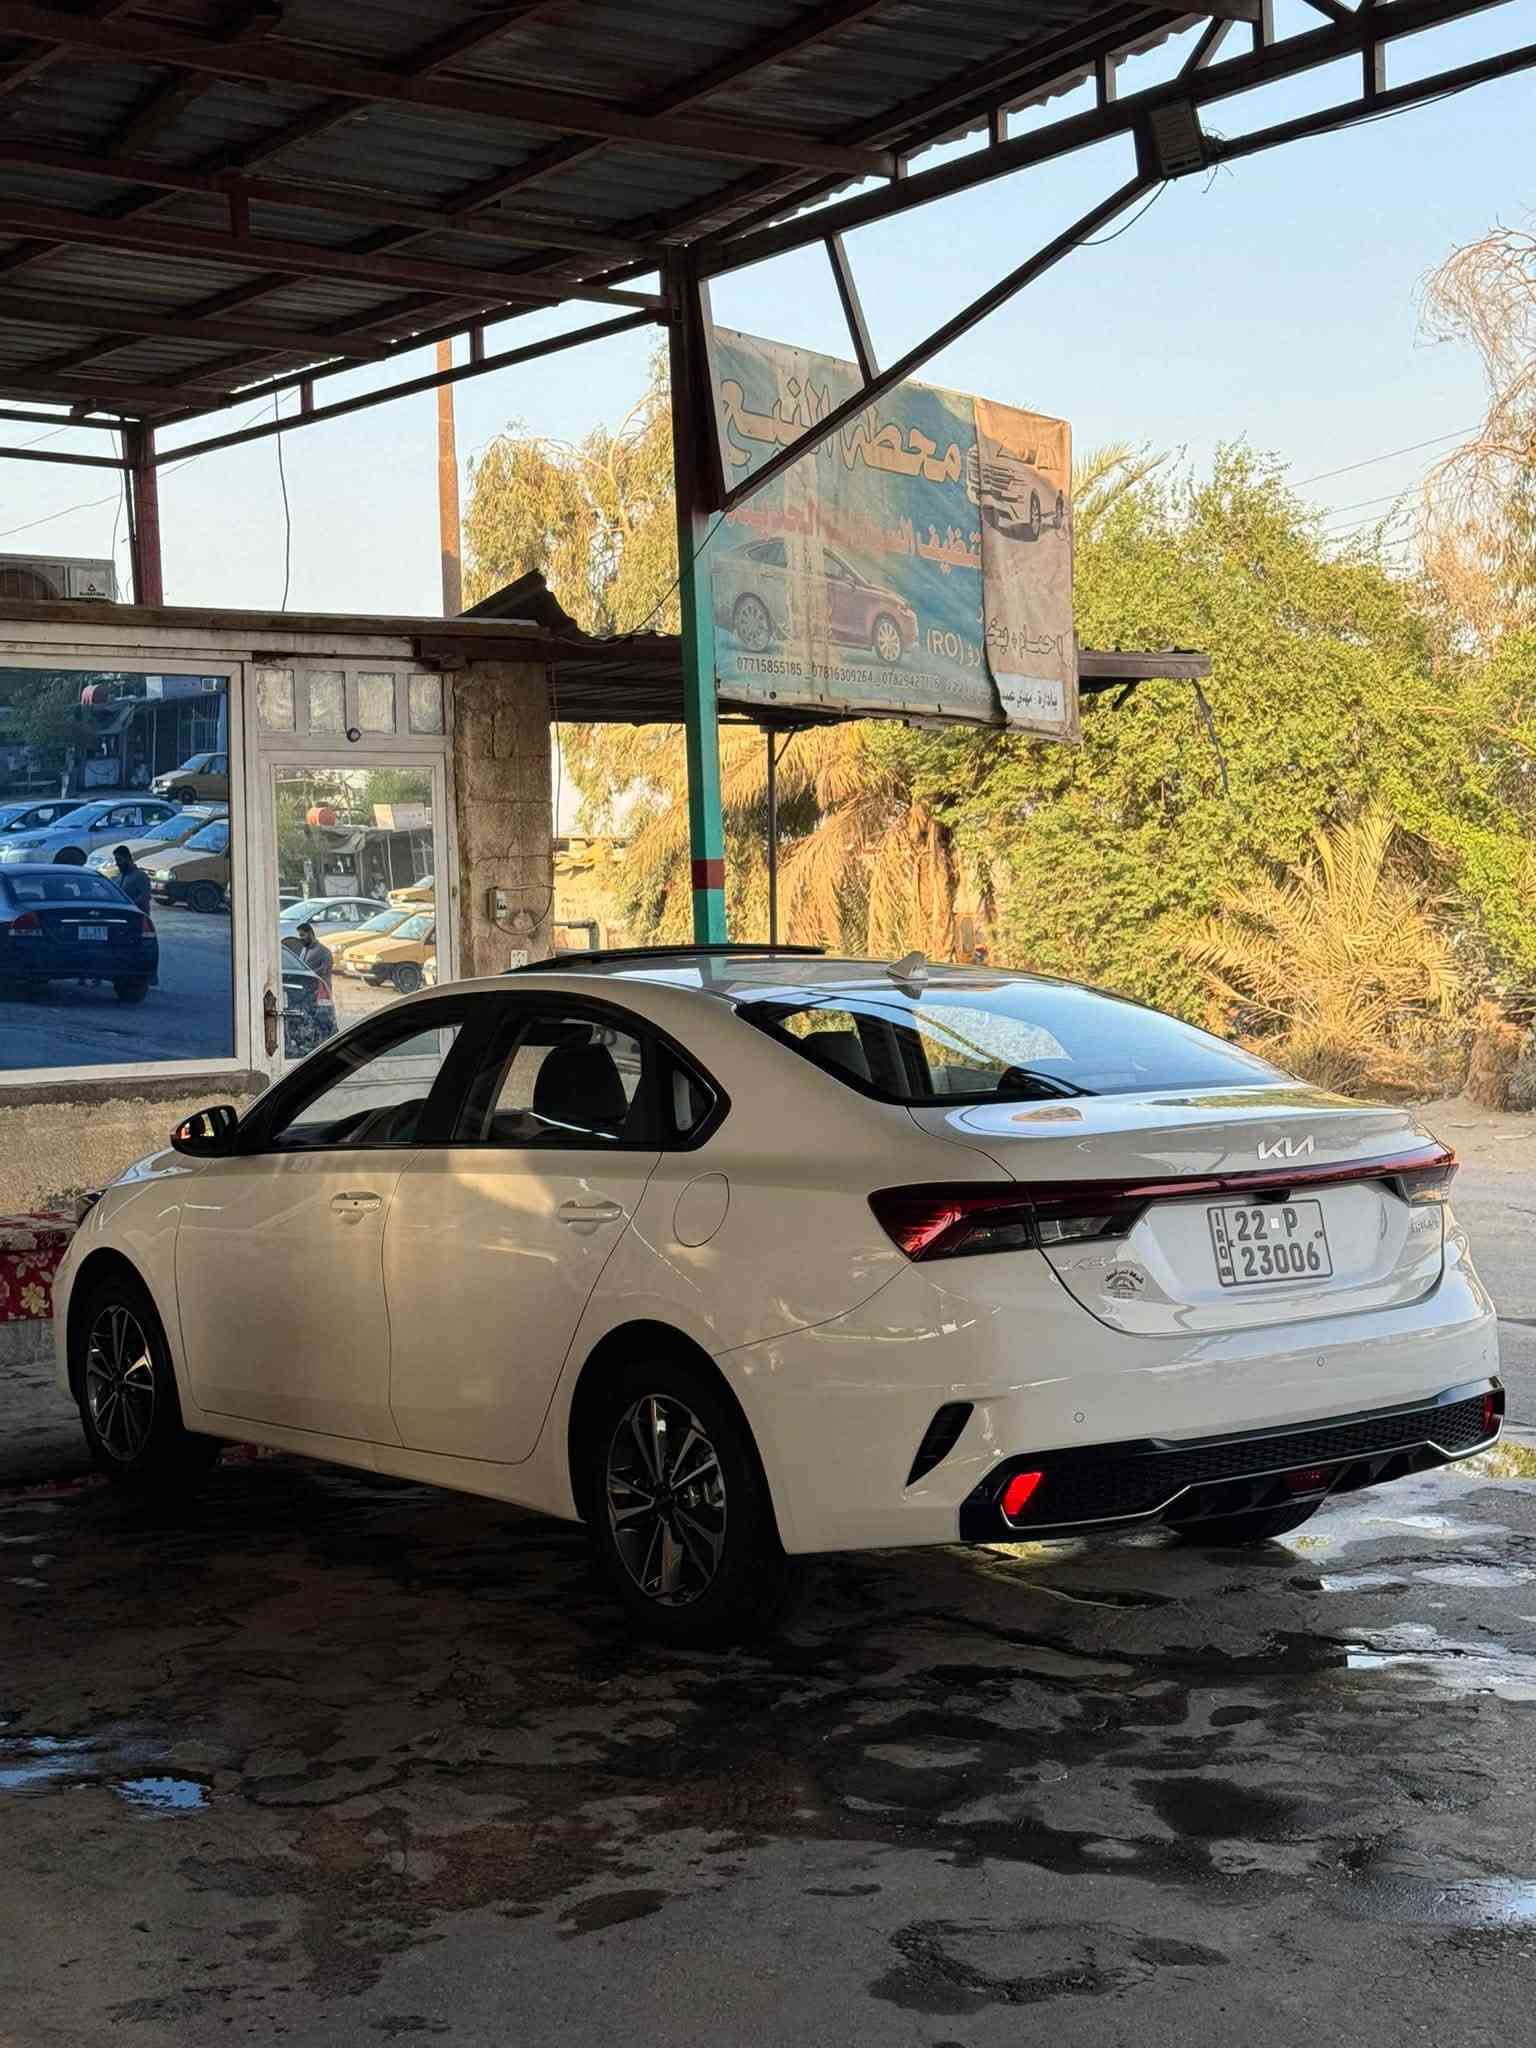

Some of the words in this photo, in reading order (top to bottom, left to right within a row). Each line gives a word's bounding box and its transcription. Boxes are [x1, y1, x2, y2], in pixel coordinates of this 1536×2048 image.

[1257, 1135, 1315, 1161] KIA
[1234, 1210, 1269, 1242] 22
[1282, 1207, 1299, 1238] P
[1241, 1241, 1321, 1277] 23006
